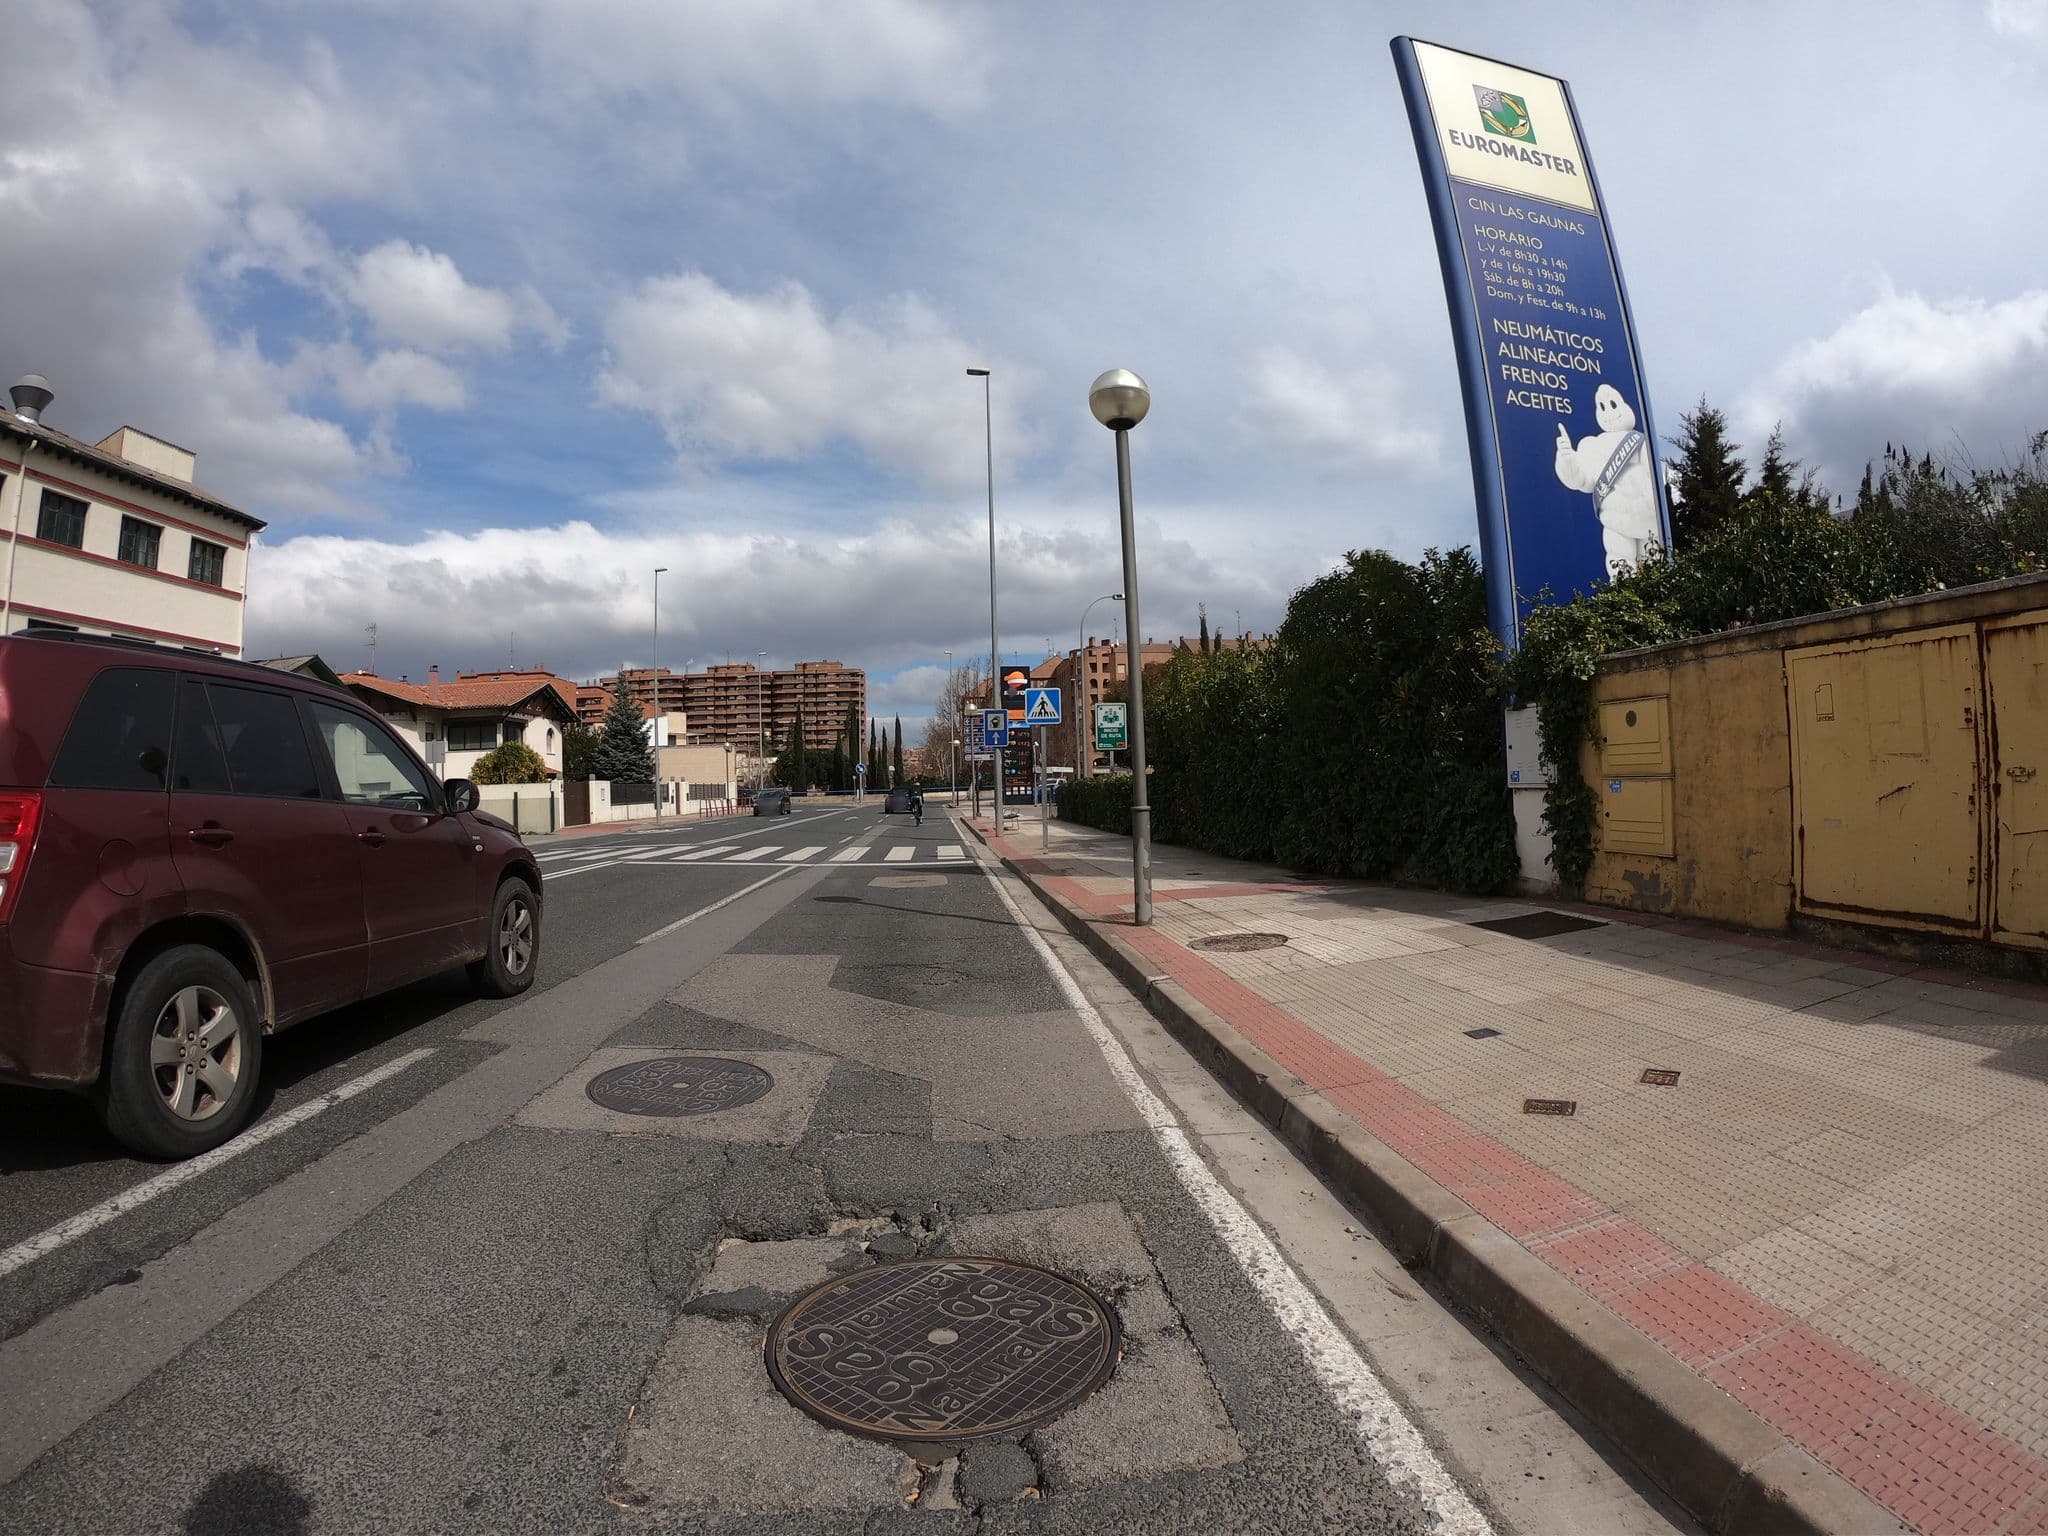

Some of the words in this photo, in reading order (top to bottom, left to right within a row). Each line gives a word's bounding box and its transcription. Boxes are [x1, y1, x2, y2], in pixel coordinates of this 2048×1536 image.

[1449, 129, 1576, 176] EUROMASTER
[1468, 198, 1496, 214] CIN
[1500, 204, 1524, 220] LAS
[1528, 211, 1584, 235] GAUNAS
[1475, 224, 1543, 250] HORARIO
[1478, 242, 1495, 254] L-V
[1500, 246, 1512, 257] de
[1515, 249, 1539, 264] 8h30
[1551, 256, 1568, 270] 14h
[1480, 259, 1487, 269] y
[1491, 259, 1503, 270] de
[1507, 260, 1524, 274] 16h
[1528, 268, 1533, 276] a
[1537, 269, 1566, 283] 19h30
[1484, 271, 1504, 284] Sáb.
[1507, 276, 1519, 286] de
[1522, 278, 1535, 290] 8h
[1538, 284, 1543, 292] a
[1546, 283, 1564, 296] 20h
[1487, 286, 1516, 302] Dom.
[1518, 295, 1524, 304] y
[1527, 294, 1550, 308] Fest.
[1552, 299, 1564, 310] de
[1566, 301, 1578, 314] 9h
[1581, 308, 1586, 316] a
[1589, 307, 1606, 320] 13h
[1494, 317, 1604, 354] NEUMÁTICOS
[1499, 342, 1601, 375] ALINEACIÓN
[1502, 365, 1569, 391] FRENOS
[1506, 389, 1572, 414] ACEITES
[1605, 433, 1641, 482] MICHELIN
[843, 1263, 982, 1338] Natural
[938, 1278, 1096, 1339] gas
[787, 1324, 948, 1403] gas
[892, 1332, 1057, 1432] Natural
